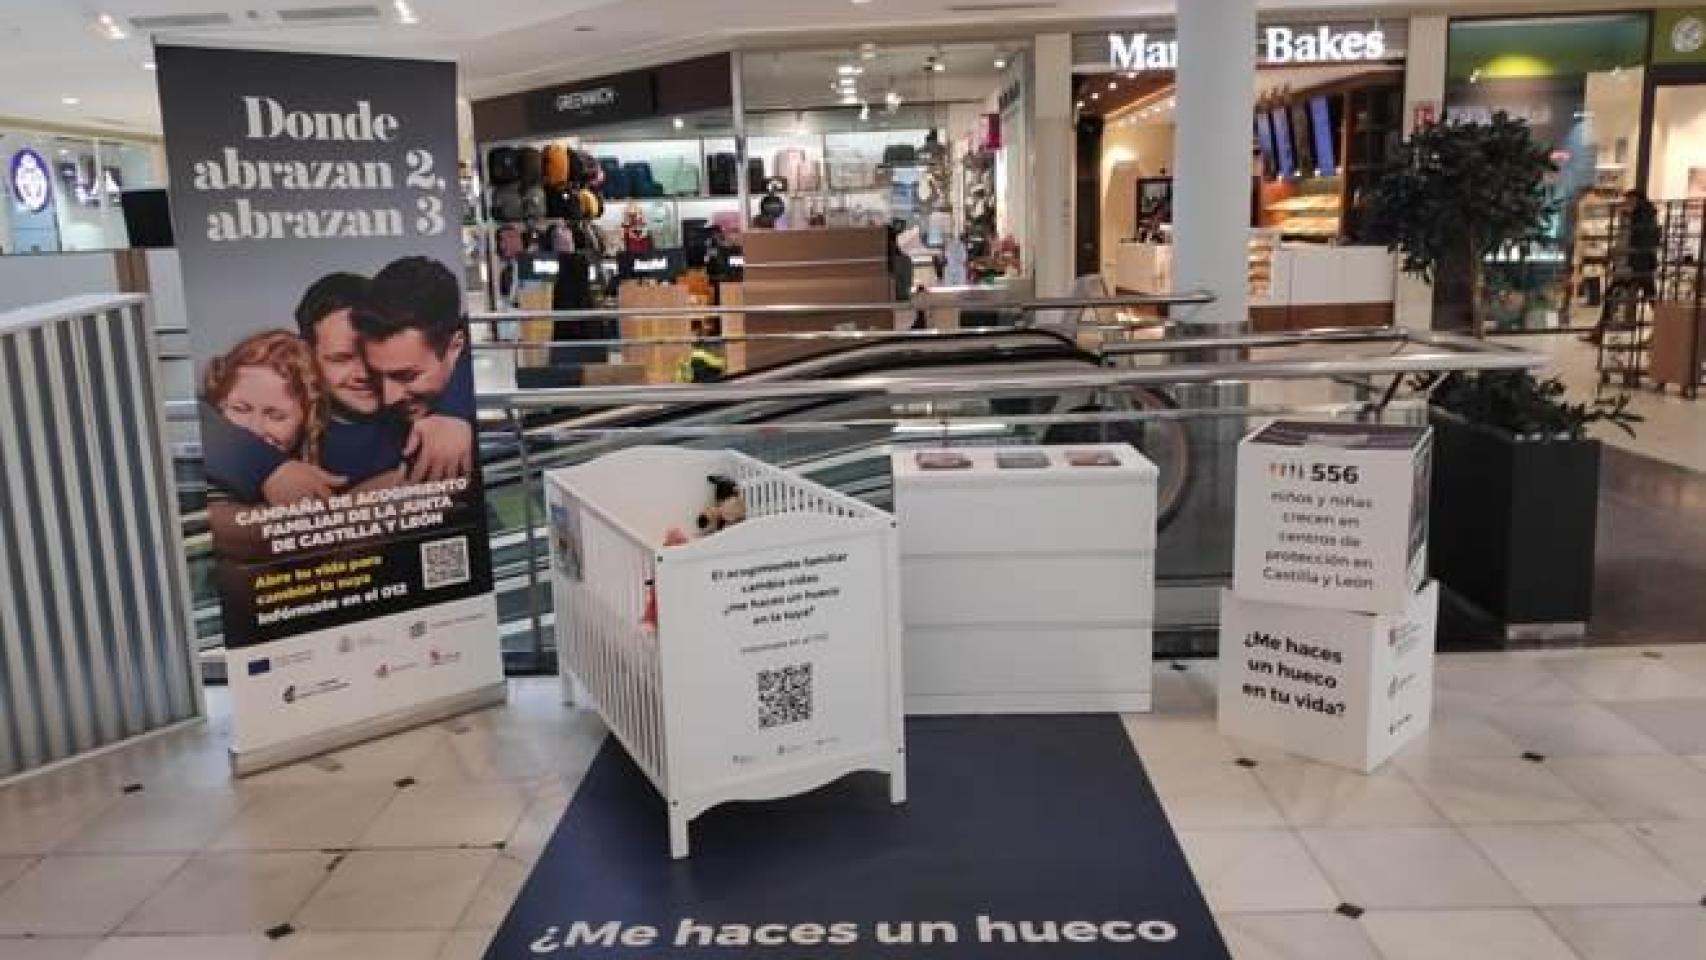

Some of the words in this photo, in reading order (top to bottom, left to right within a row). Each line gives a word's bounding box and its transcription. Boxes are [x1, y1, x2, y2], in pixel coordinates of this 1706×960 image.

[1266, 26, 1385, 62] Bakes
[242, 96, 399, 141] Donde
[193, 147, 395, 190] abrazan
[405, 149, 446, 192] 2,
[206, 199, 404, 241] abrazan
[416, 196, 446, 236] 3
[1310, 463, 1360, 484] 556
[235, 497, 324, 526] CAMPAÑA
[329, 494, 352, 510] DE
[357, 478, 467, 505] ACOGIMIENTO
[1271, 490, 1313, 505] niños
[1317, 496, 1326, 508] y
[1330, 493, 1372, 508] niñas
[263, 512, 345, 539] FAMILIAR
[348, 506, 371, 522] DE
[374, 502, 397, 518] LA
[401, 495, 453, 514] JUNTA
[272, 537, 296, 554] DE
[300, 524, 382, 549] CASTILLA
[386, 520, 396, 534] Y
[401, 510, 444, 529] LEÓN
[1284, 512, 1334, 524] crecen
[1338, 517, 1359, 528] en
[1279, 532, 1336, 547] centros
[1340, 535, 1361, 547] de
[255, 573, 291, 589] Abre
[295, 569, 312, 580] tu
[315, 561, 348, 577] vida
[349, 556, 383, 573] para
[711, 570, 723, 581] El
[803, 553, 849, 567] familiar
[1266, 550, 1350, 567] protección
[1354, 559, 1372, 569] en
[256, 584, 317, 604] cambiar
[320, 579, 335, 591] la
[337, 574, 371, 591] suya
[1263, 567, 1318, 583] Castilla
[1323, 575, 1330, 588] y
[1336, 574, 1373, 589] León
[341, 596, 361, 606] en
[364, 588, 379, 602] el
[380, 582, 408, 599] 012
[750, 597, 785, 608] haces
[787, 594, 803, 603] un
[804, 588, 839, 599] hueco
[753, 615, 769, 625] en
[771, 611, 782, 622] la
[1244, 631, 1282, 650] ¿Me
[1286, 637, 1342, 665] haces
[1248, 659, 1272, 674] un
[1278, 662, 1336, 688] hueco
[1242, 683, 1266, 699] en
[1271, 687, 1290, 704] tu
[1294, 693, 1346, 718] vida?
[530, 920, 658, 952] ¿Me
[674, 917, 859, 948] haces
[875, 919, 957, 944] un
[977, 915, 1177, 944] hueco
